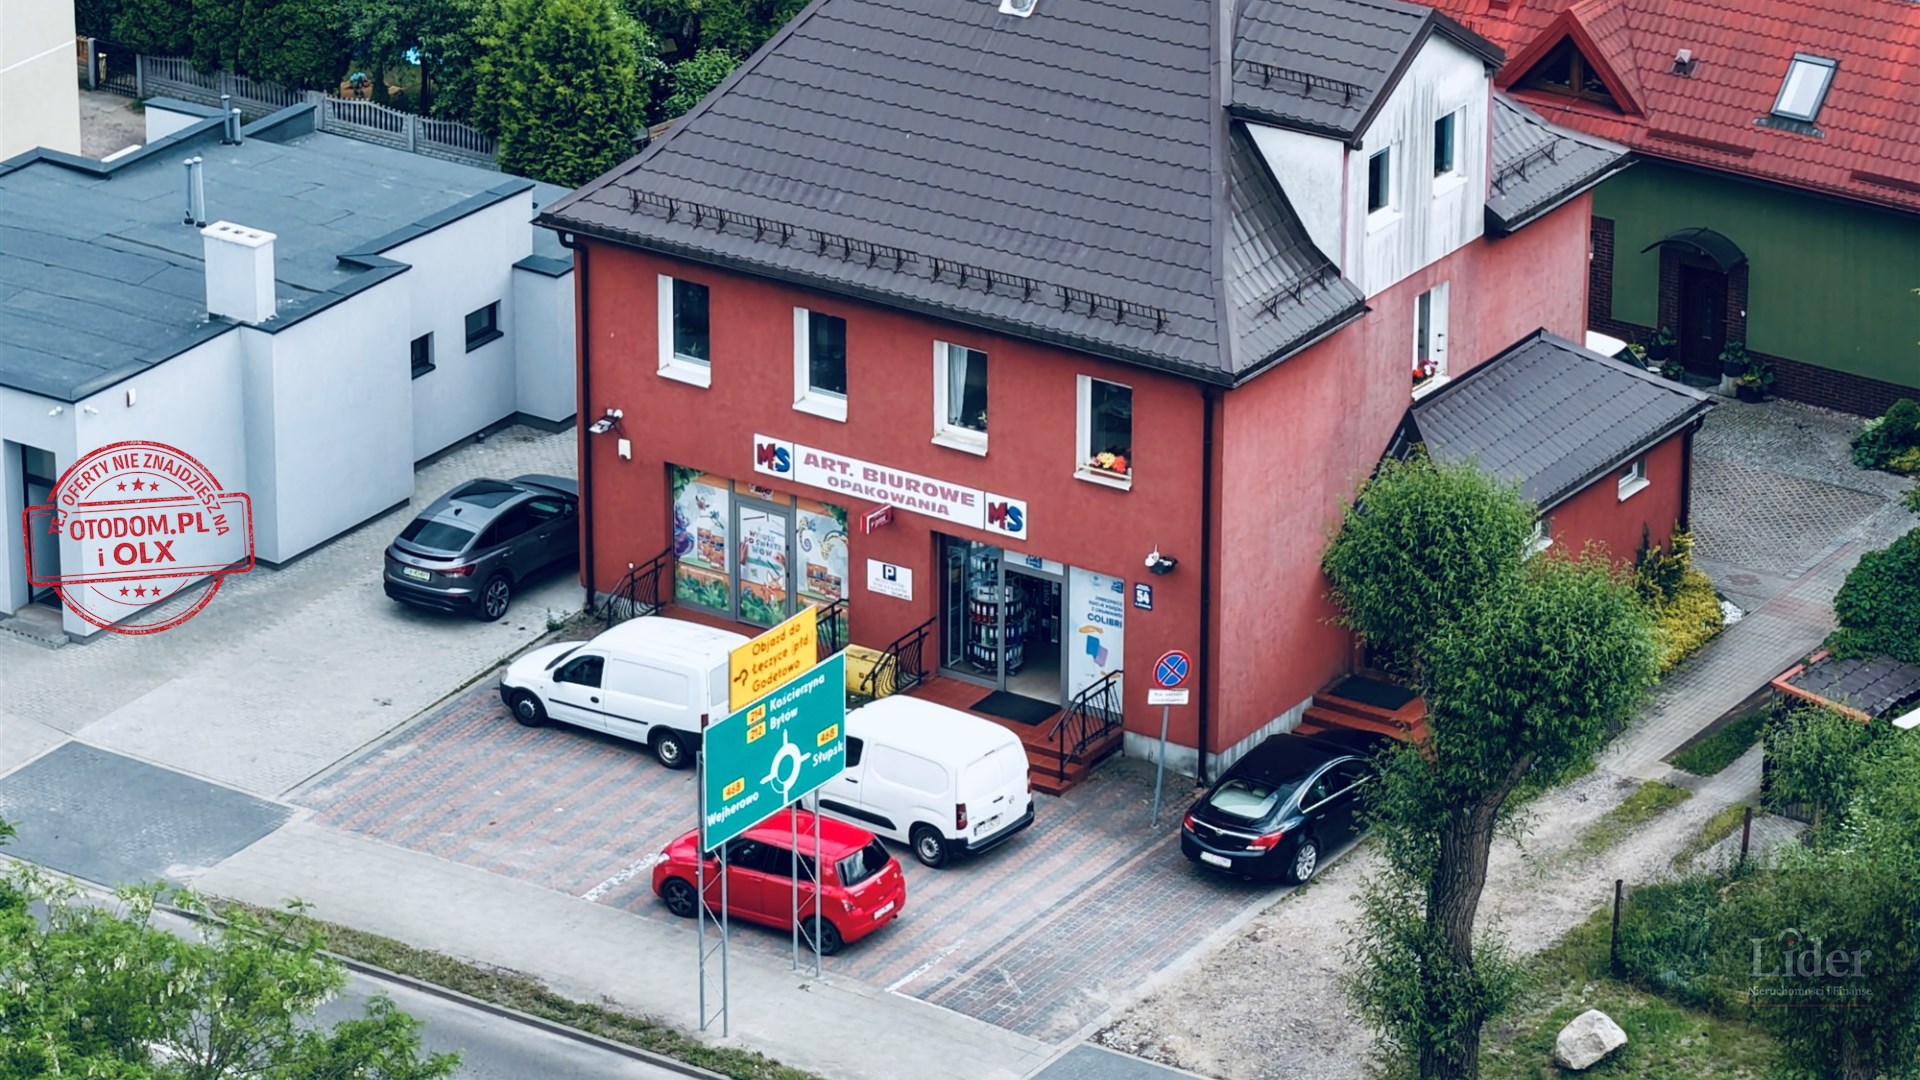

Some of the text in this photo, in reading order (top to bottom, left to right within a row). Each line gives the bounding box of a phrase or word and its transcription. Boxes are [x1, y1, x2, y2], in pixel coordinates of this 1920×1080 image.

[804, 452, 975, 507] ART. BIUROWE
[827, 476, 949, 516] OPAKOWANIA
[885, 566, 894, 579] P
[1136, 589, 1150, 604] 54
[1087, 613, 1123, 628] COLIBRI
[752, 623, 801, 656] Objazd do
[752, 649, 788, 675] Łęczyce
[752, 660, 801, 692] Godętowo
[770, 674, 825, 712] Kościerzyna
[750, 707, 763, 723] 214
[769, 707, 798, 730] Bytów
[812, 740, 843, 767] Słupsk
[707, 792, 759, 827] Wejherowo
